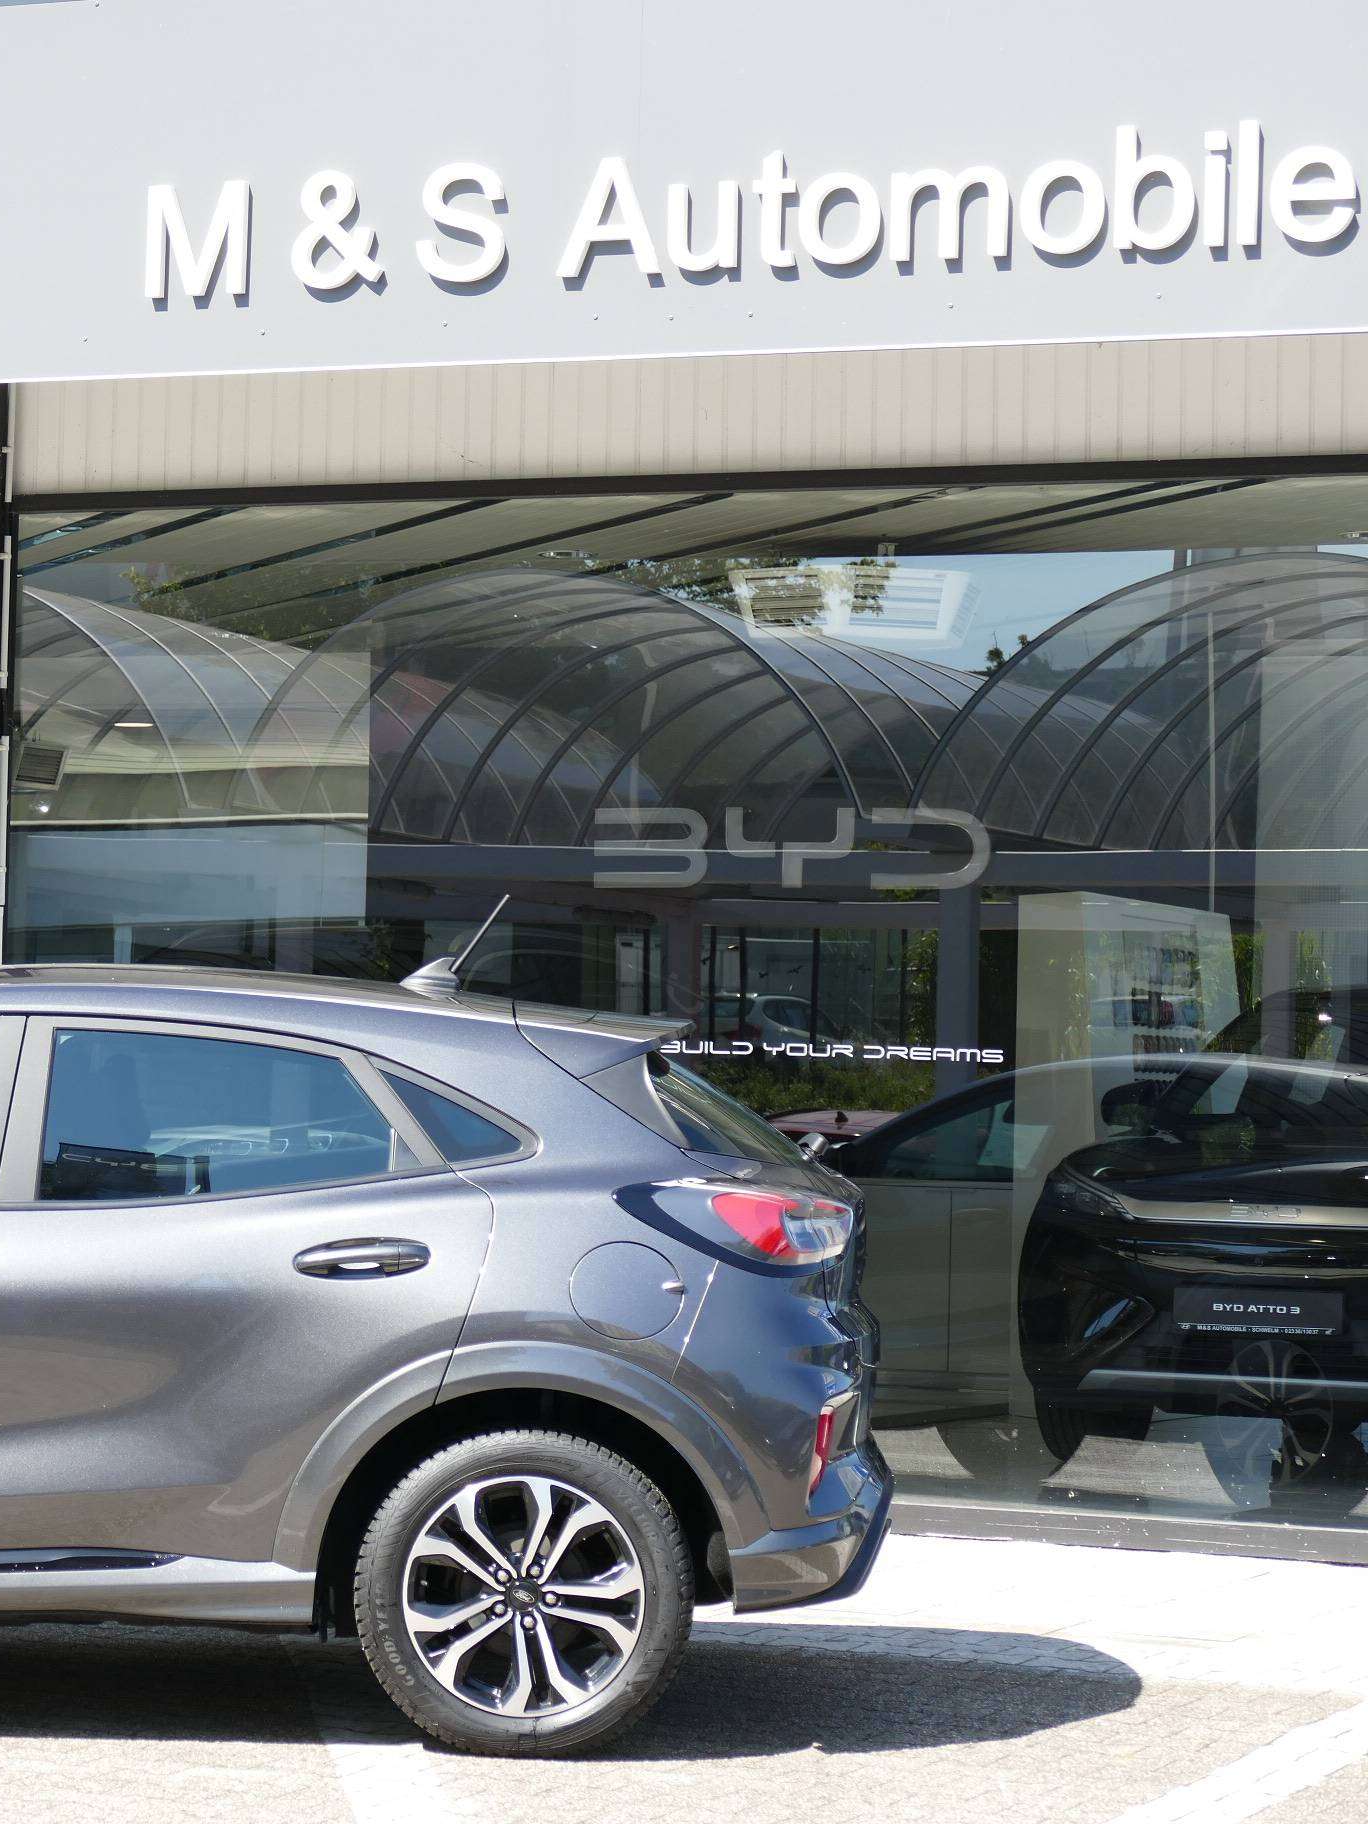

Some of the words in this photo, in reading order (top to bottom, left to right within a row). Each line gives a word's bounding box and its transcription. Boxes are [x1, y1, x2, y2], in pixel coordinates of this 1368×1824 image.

[145, 180, 252, 299] M
[291, 169, 387, 291] &
[416, 162, 507, 285] S
[556, 119, 1358, 280] Automobile
[594, 807, 991, 890] BYD
[659, 1040, 754, 1055] BUILD
[763, 1042, 854, 1059] YOUR
[863, 1045, 1005, 1064] DREAMS
[1212, 1303, 1244, 1312] BYD
[1247, 1304, 1287, 1314] ATTO
[1289, 1306, 1301, 1314] 3
